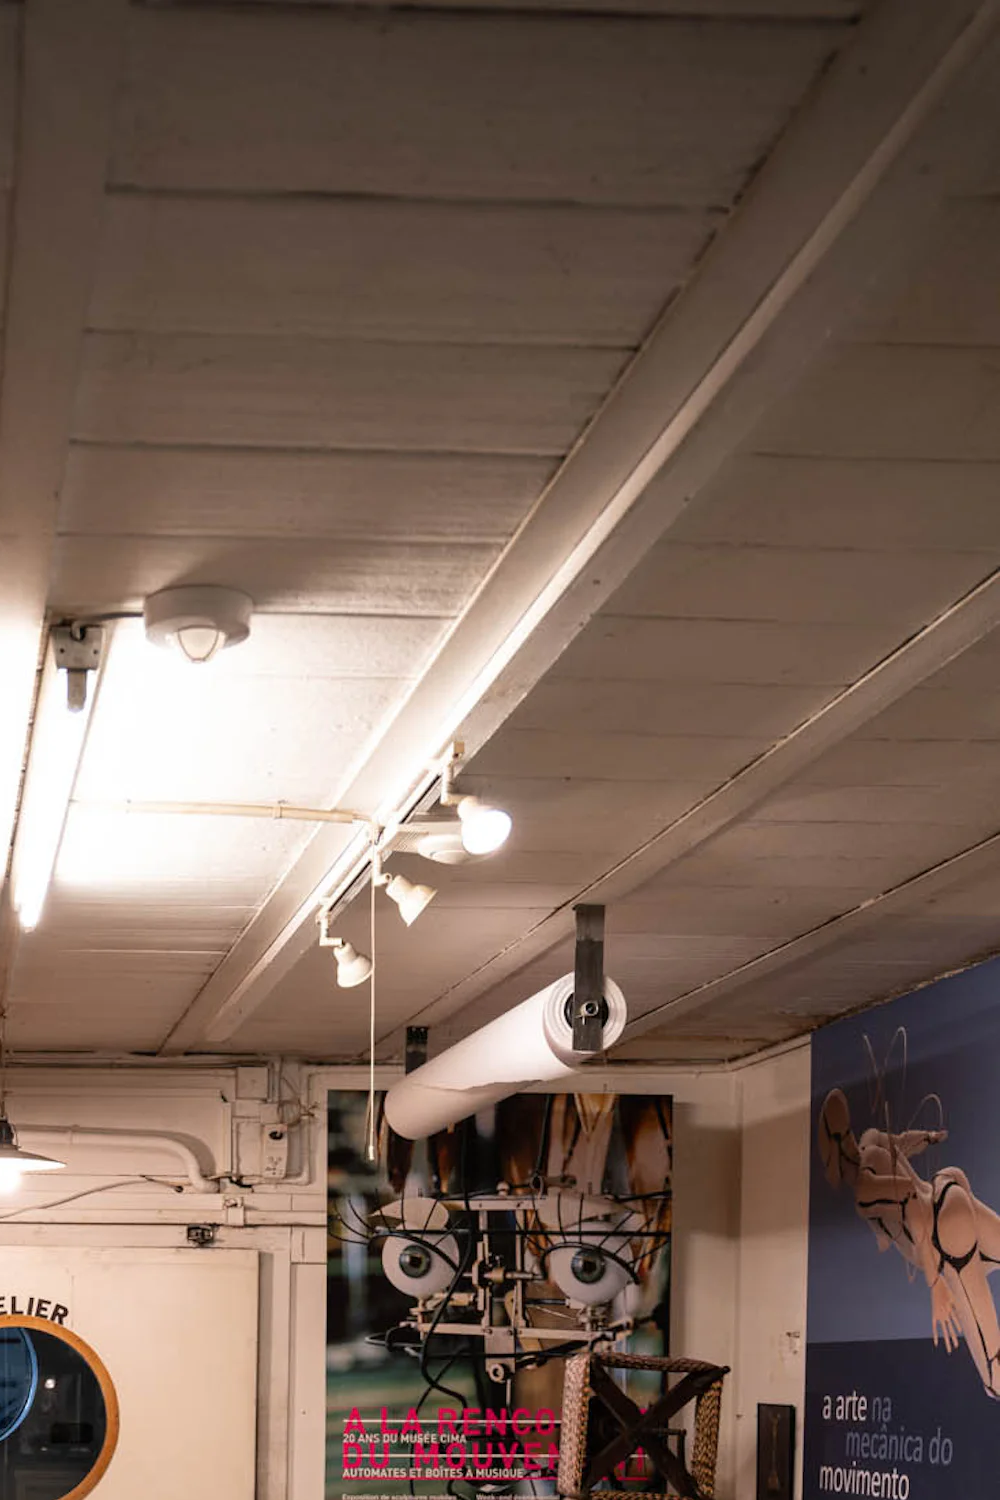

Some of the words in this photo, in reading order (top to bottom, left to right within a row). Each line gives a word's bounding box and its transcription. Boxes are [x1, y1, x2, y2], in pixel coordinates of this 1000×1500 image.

[343, 1406, 366, 1435] A
[380, 1406, 423, 1435] LA
[437, 1407, 561, 1437] RENCO
[822, 1394, 832, 1420] a
[835, 1390, 868, 1421] arte
[872, 1396, 892, 1422] na
[343, 1433, 356, 1443] 20
[358, 1433, 380, 1443] ANS
[383, 1433, 398, 1443] DU
[401, 1430, 437, 1443] MUSÉE
[440, 1433, 467, 1443] CIMA
[845, 1423, 923, 1462] mecânica
[929, 1426, 953, 1465] do
[342, 1442, 390, 1469] DU
[343, 1467, 407, 1478] AUTOMATES
[409, 1467, 423, 1478] ET
[425, 1465, 464, 1478] BOÎTES
[465, 1465, 474, 1478] À
[475, 1467, 524, 1478] MUSIQUE
[819, 1461, 910, 1500] movimento
